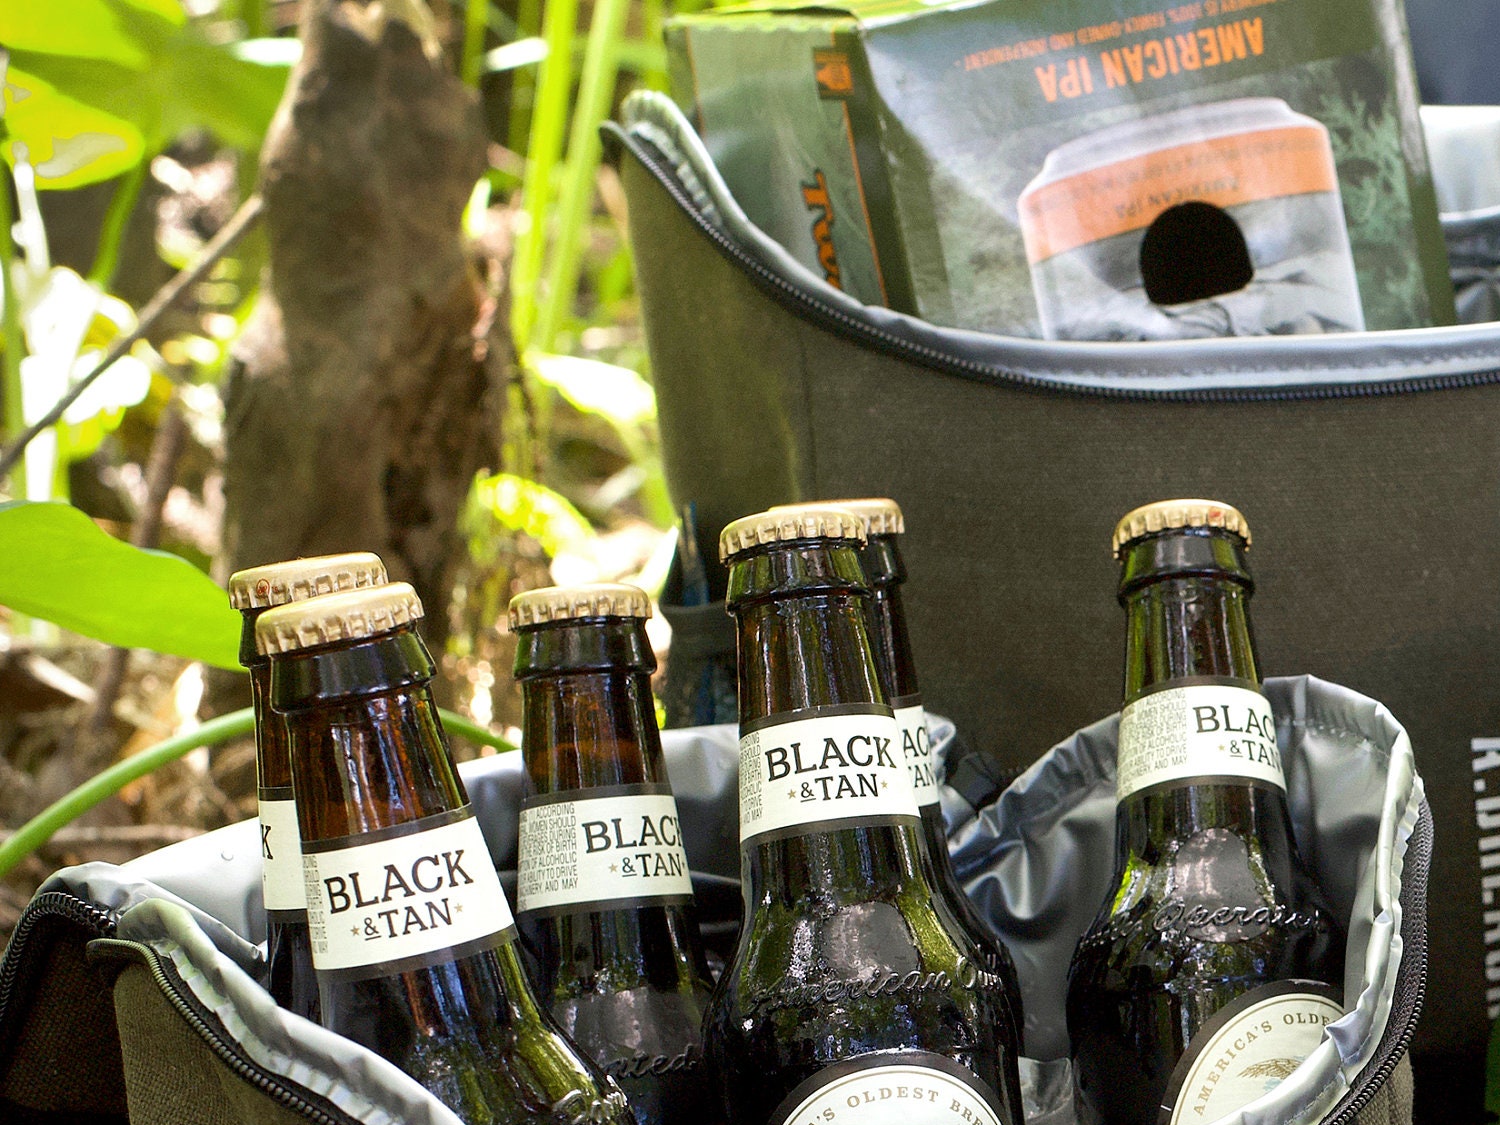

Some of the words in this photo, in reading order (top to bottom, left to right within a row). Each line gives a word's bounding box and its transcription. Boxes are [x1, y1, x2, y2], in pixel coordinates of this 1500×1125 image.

[1102, 17, 1264, 89] AMERICAN
[1034, 57, 1094, 102] IPA
[1192, 704, 1277, 744] BLAC
[764, 735, 897, 782] BLACK
[1154, 759, 1169, 770] AND
[1171, 754, 1188, 766] MAY
[1166, 744, 1188, 757] DRIVE
[549, 815, 576, 831] SHOULD
[538, 852, 578, 868] ALCOHOLIC
[555, 865, 578, 878] DRIVE
[324, 849, 474, 914] BLACK
[561, 877, 579, 890] MAY
[1193, 1020, 1272, 1116] AMERICA'S
[1283, 1012, 1330, 1026] OLDE
[846, 1085, 940, 1109] OLDEST
